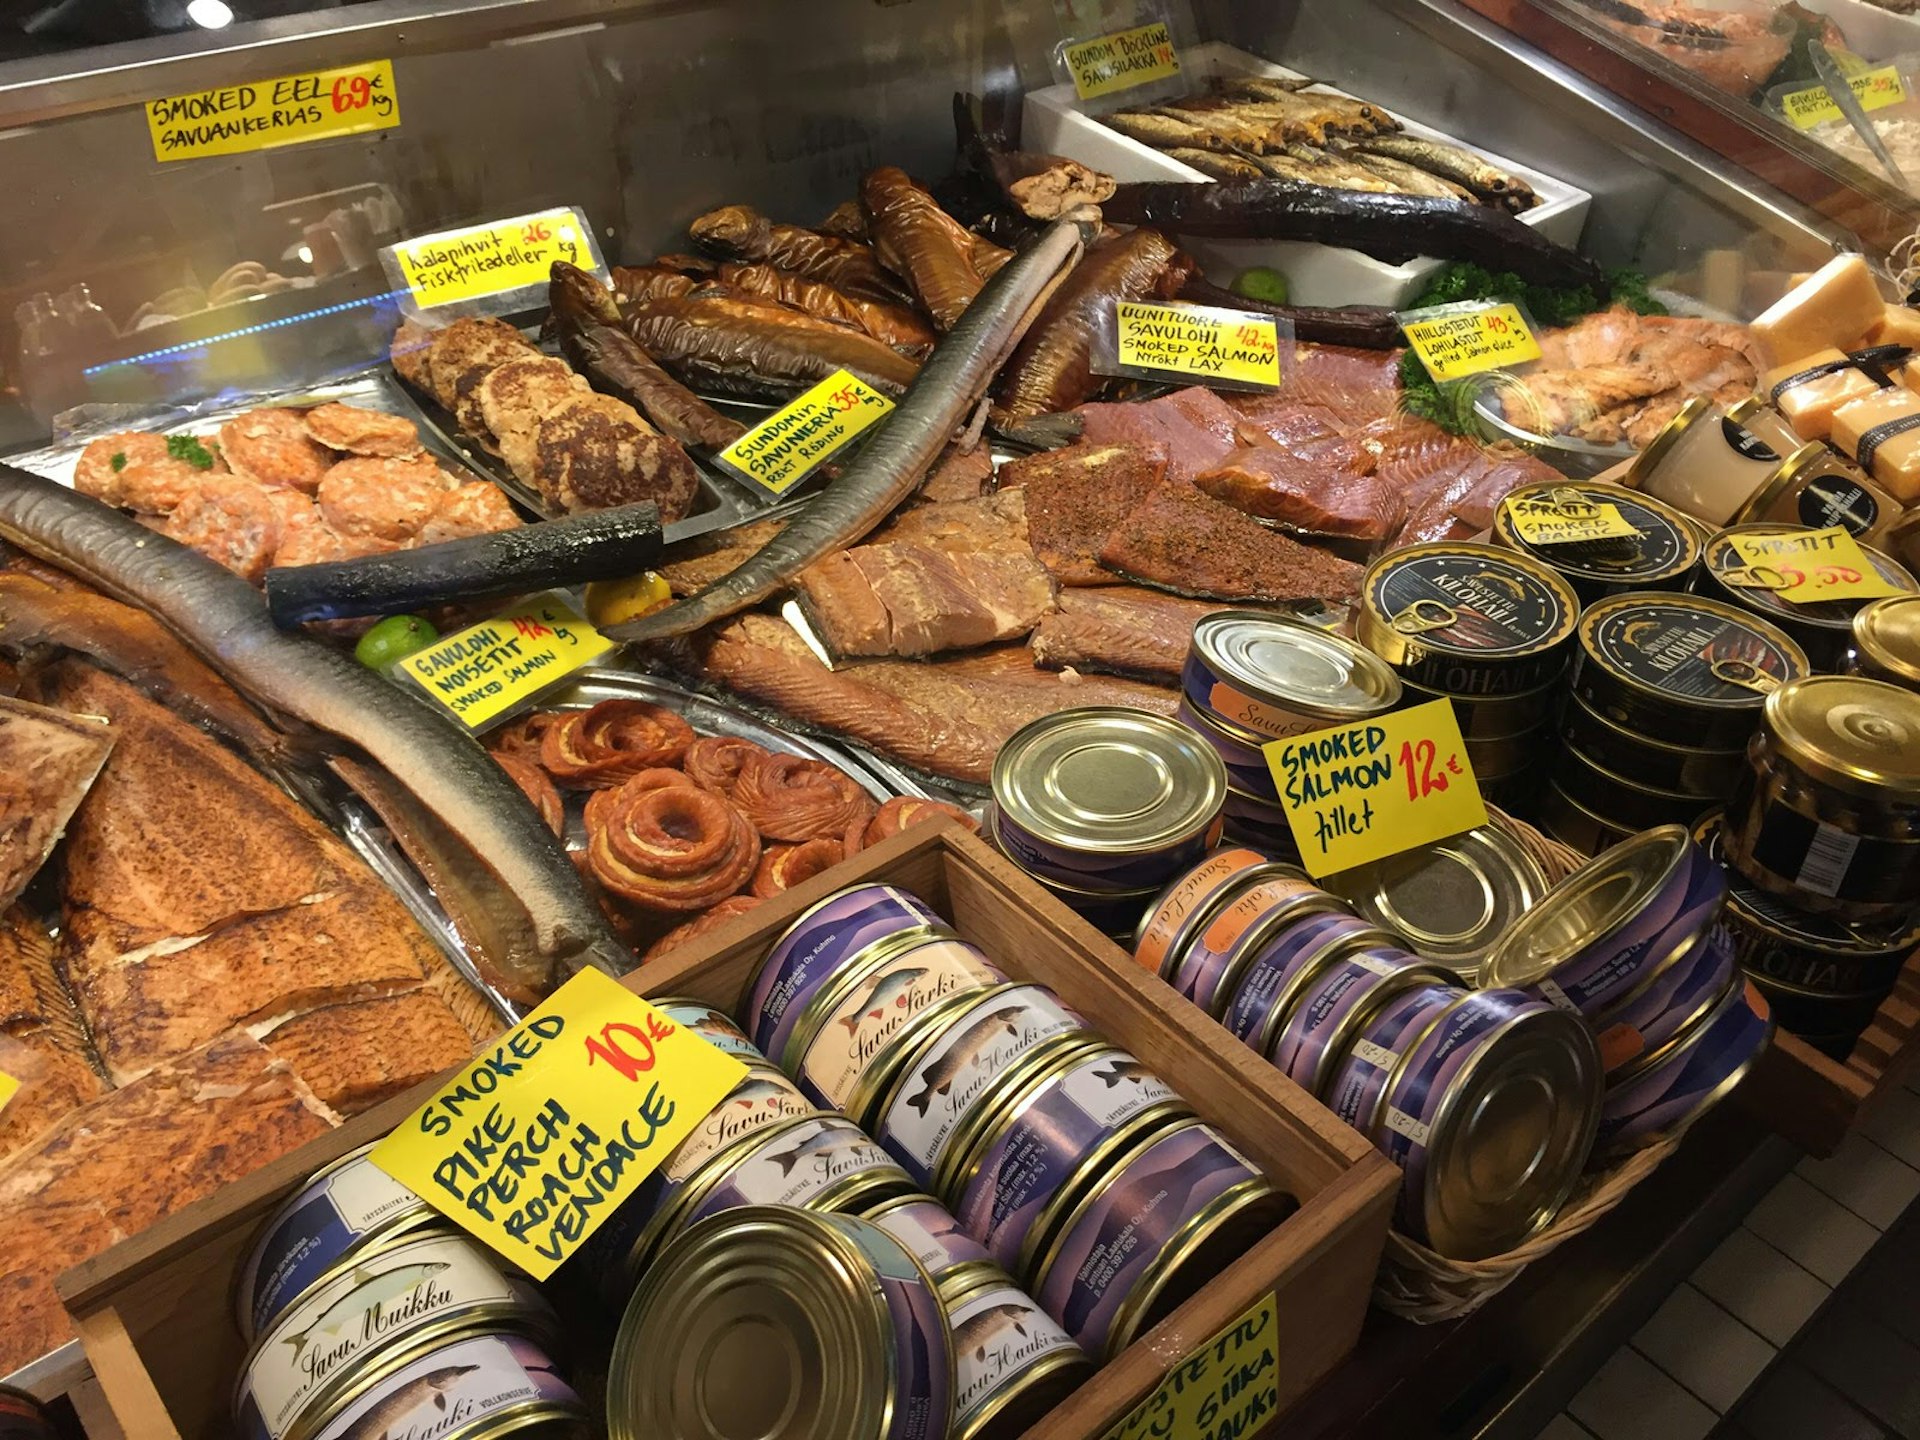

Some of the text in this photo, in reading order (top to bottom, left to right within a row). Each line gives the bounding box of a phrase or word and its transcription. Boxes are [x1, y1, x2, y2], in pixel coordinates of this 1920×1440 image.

[152, 87, 256, 126] SMOKED
[272, 77, 332, 106] EEL
[161, 106, 322, 151] SAVUANKERIAS
[520, 221, 551, 246] 26
[416, 246, 548, 293] Fiskfrikadeller
[1123, 337, 1274, 366] SMOKED SALMON
[1128, 321, 1218, 344] SAVULOHI
[1189, 357, 1223, 372] LAX
[1524, 520, 1609, 535] SMOKED
[415, 628, 502, 677] SAVULOHI
[449, 650, 557, 712] SMOKED SALMON
[1281, 726, 1387, 777] SMOKED
[1285, 753, 1392, 810] SALMON
[1314, 798, 1375, 854] fillet
[420, 1014, 565, 1137] SMOKED
[433, 1102, 516, 1201] PIKE
[466, 1098, 570, 1221] PERCH
[535, 1081, 676, 1261] VENDACE
[503, 1122, 600, 1244] ROACH
[1104, 1224, 1135, 1260] Laatukala
[1143, 1189, 1168, 1214] Kuhmo
[1078, 1243, 1107, 1282] Valmistaja
[1098, 1266, 1115, 1288] 0400
[1111, 1249, 1126, 1268] 397
[1121, 1235, 1138, 1253] 926
